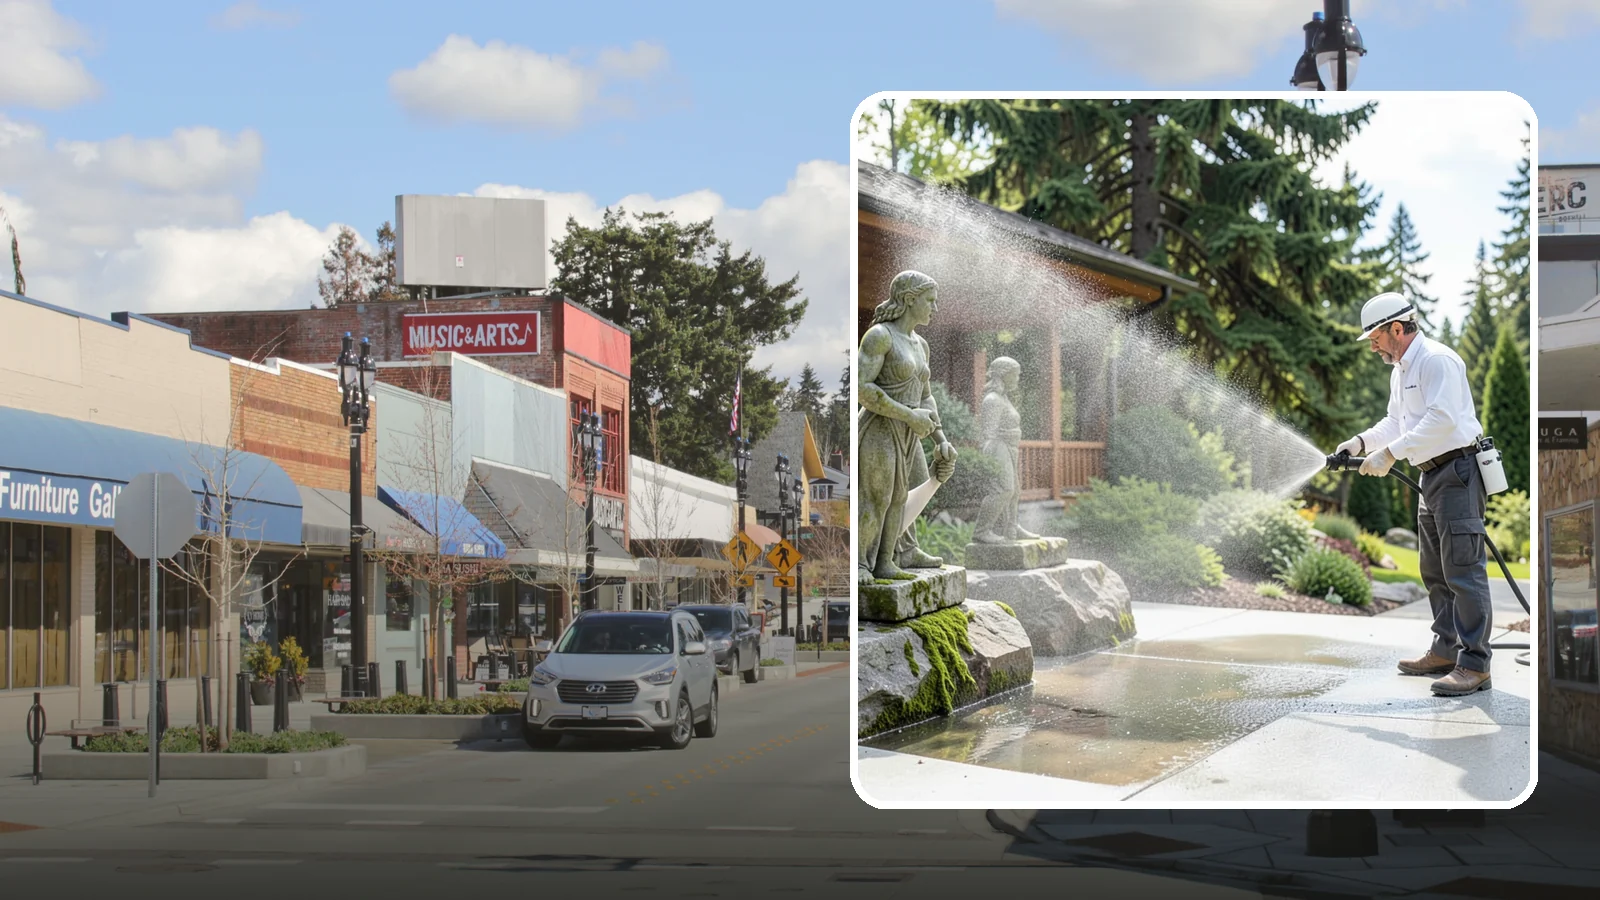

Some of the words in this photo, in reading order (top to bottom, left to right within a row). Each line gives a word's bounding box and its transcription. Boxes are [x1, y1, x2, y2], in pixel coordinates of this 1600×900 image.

[409, 323, 520, 349] MUSIC&ARTS
[1540, 427, 1578, 437] UGA
[0, 471, 79, 515] Furniture
[453, 563, 479, 575] SUSHI
